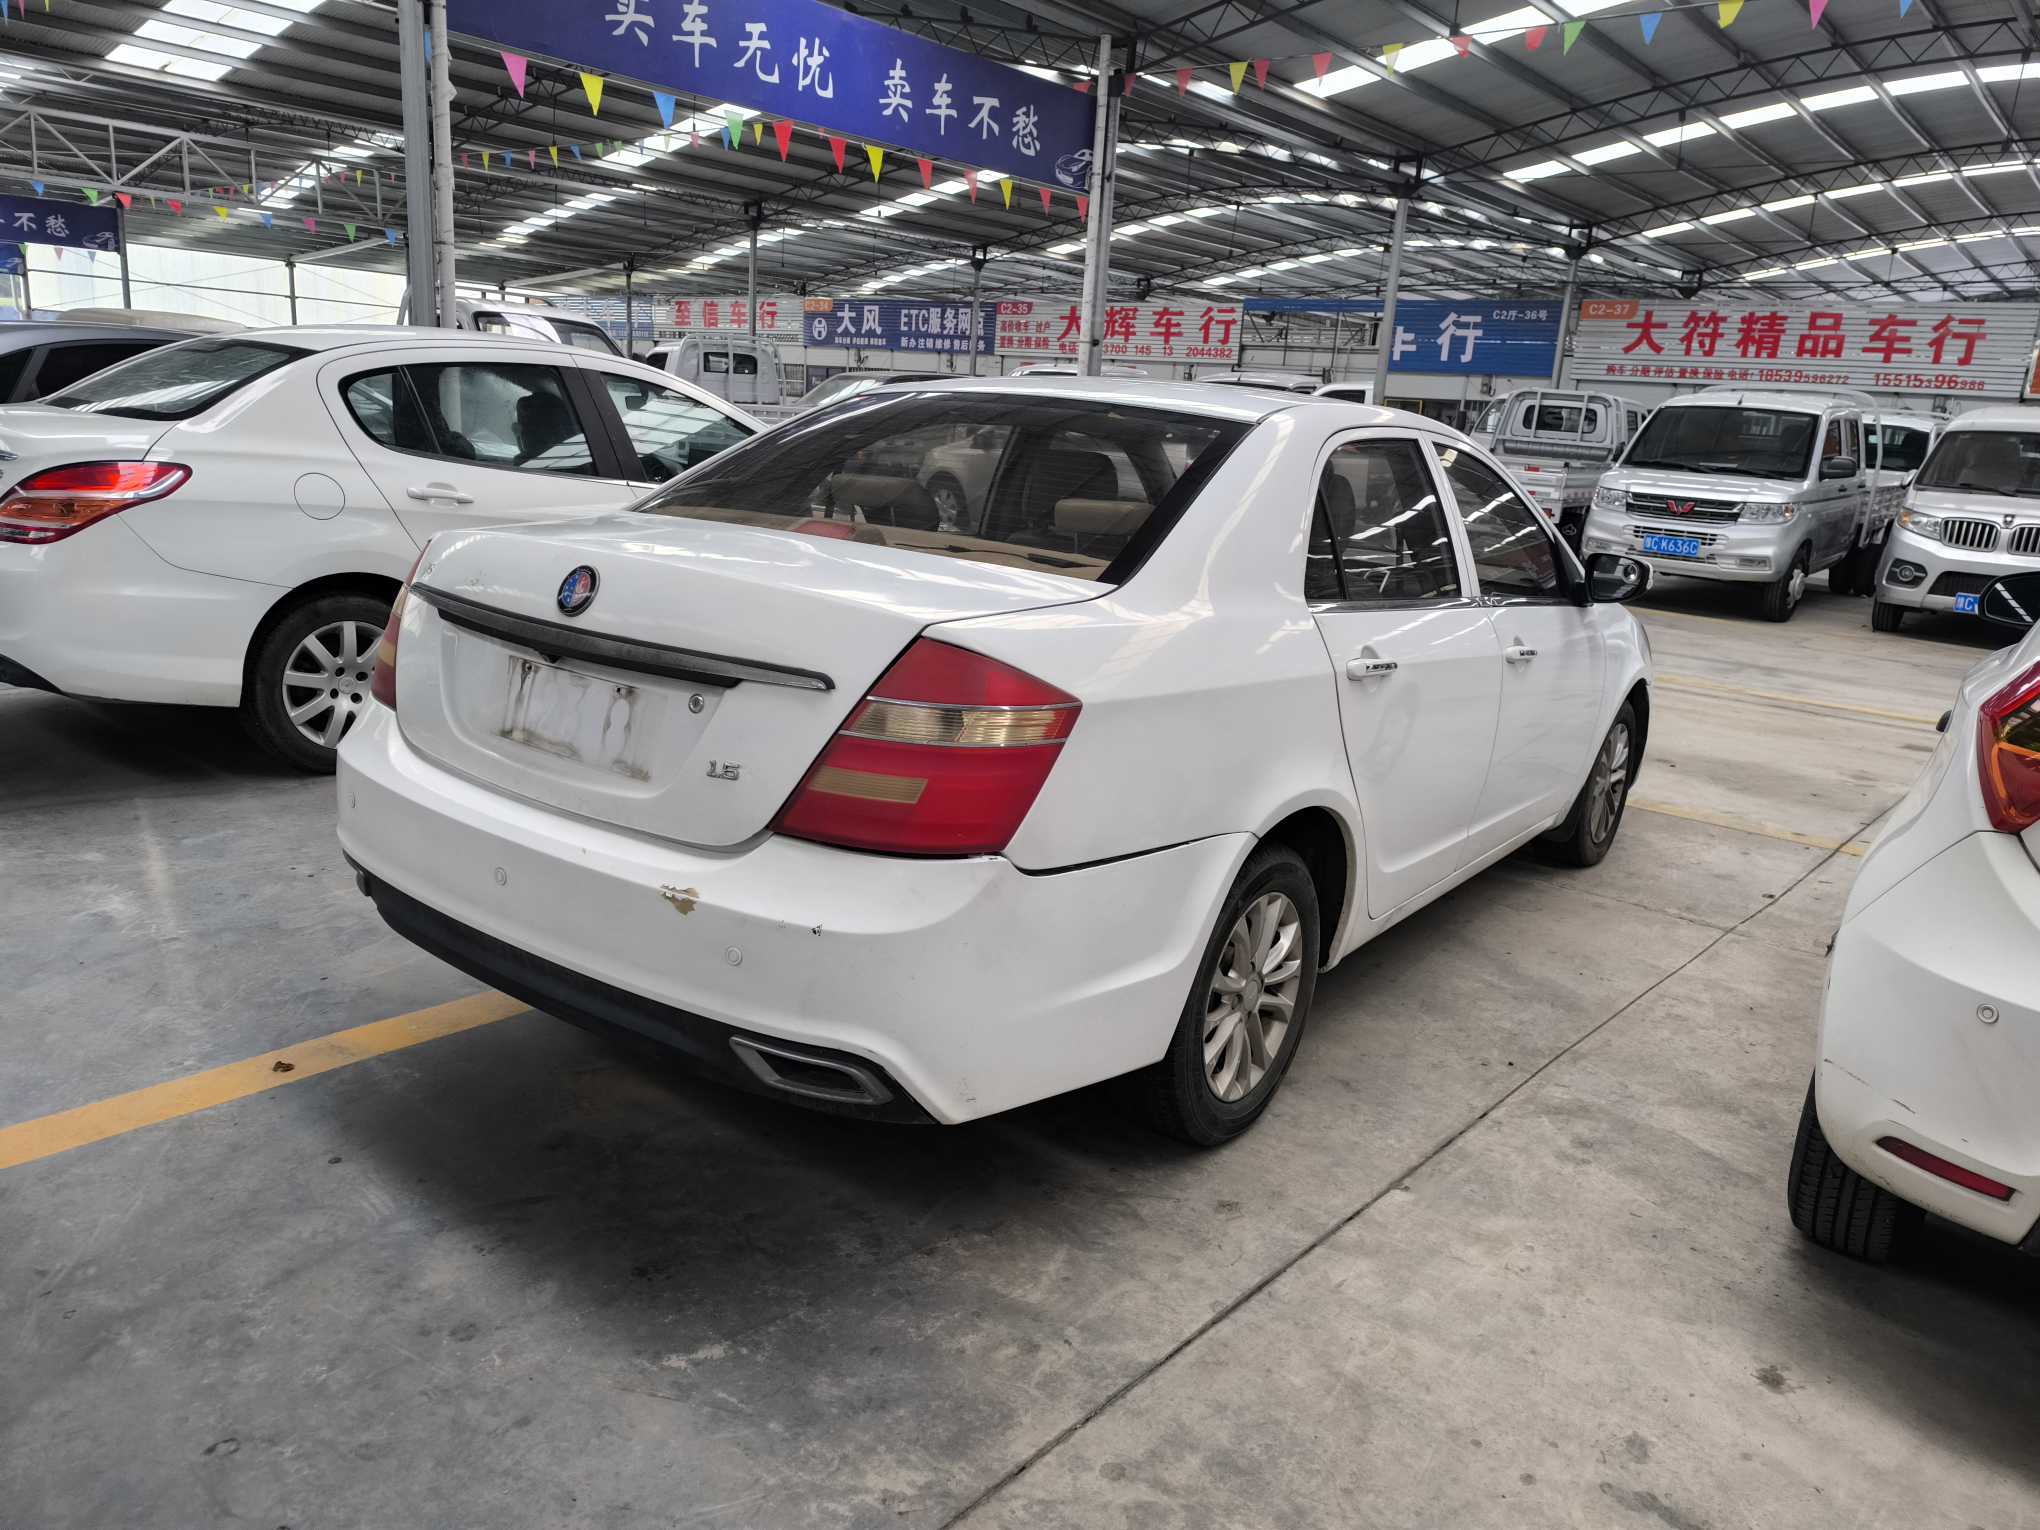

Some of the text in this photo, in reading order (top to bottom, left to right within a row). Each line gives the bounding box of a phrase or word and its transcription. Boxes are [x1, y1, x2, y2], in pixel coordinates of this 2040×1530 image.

[878, 58, 1041, 157] 卖车不愁
[0, 212, 70, 238] 不愁
[674, 299, 778, 329] 至信车行
[836, 303, 882, 335] 大风
[1000, 303, 1028, 314] C2-35
[1493, 310, 1548, 321] C2厅-36号
[1588, 304, 1630, 315] C2-37
[1057, 305, 1239, 346] 大辉车行
[1621, 309, 1987, 366] 大符精品车行
